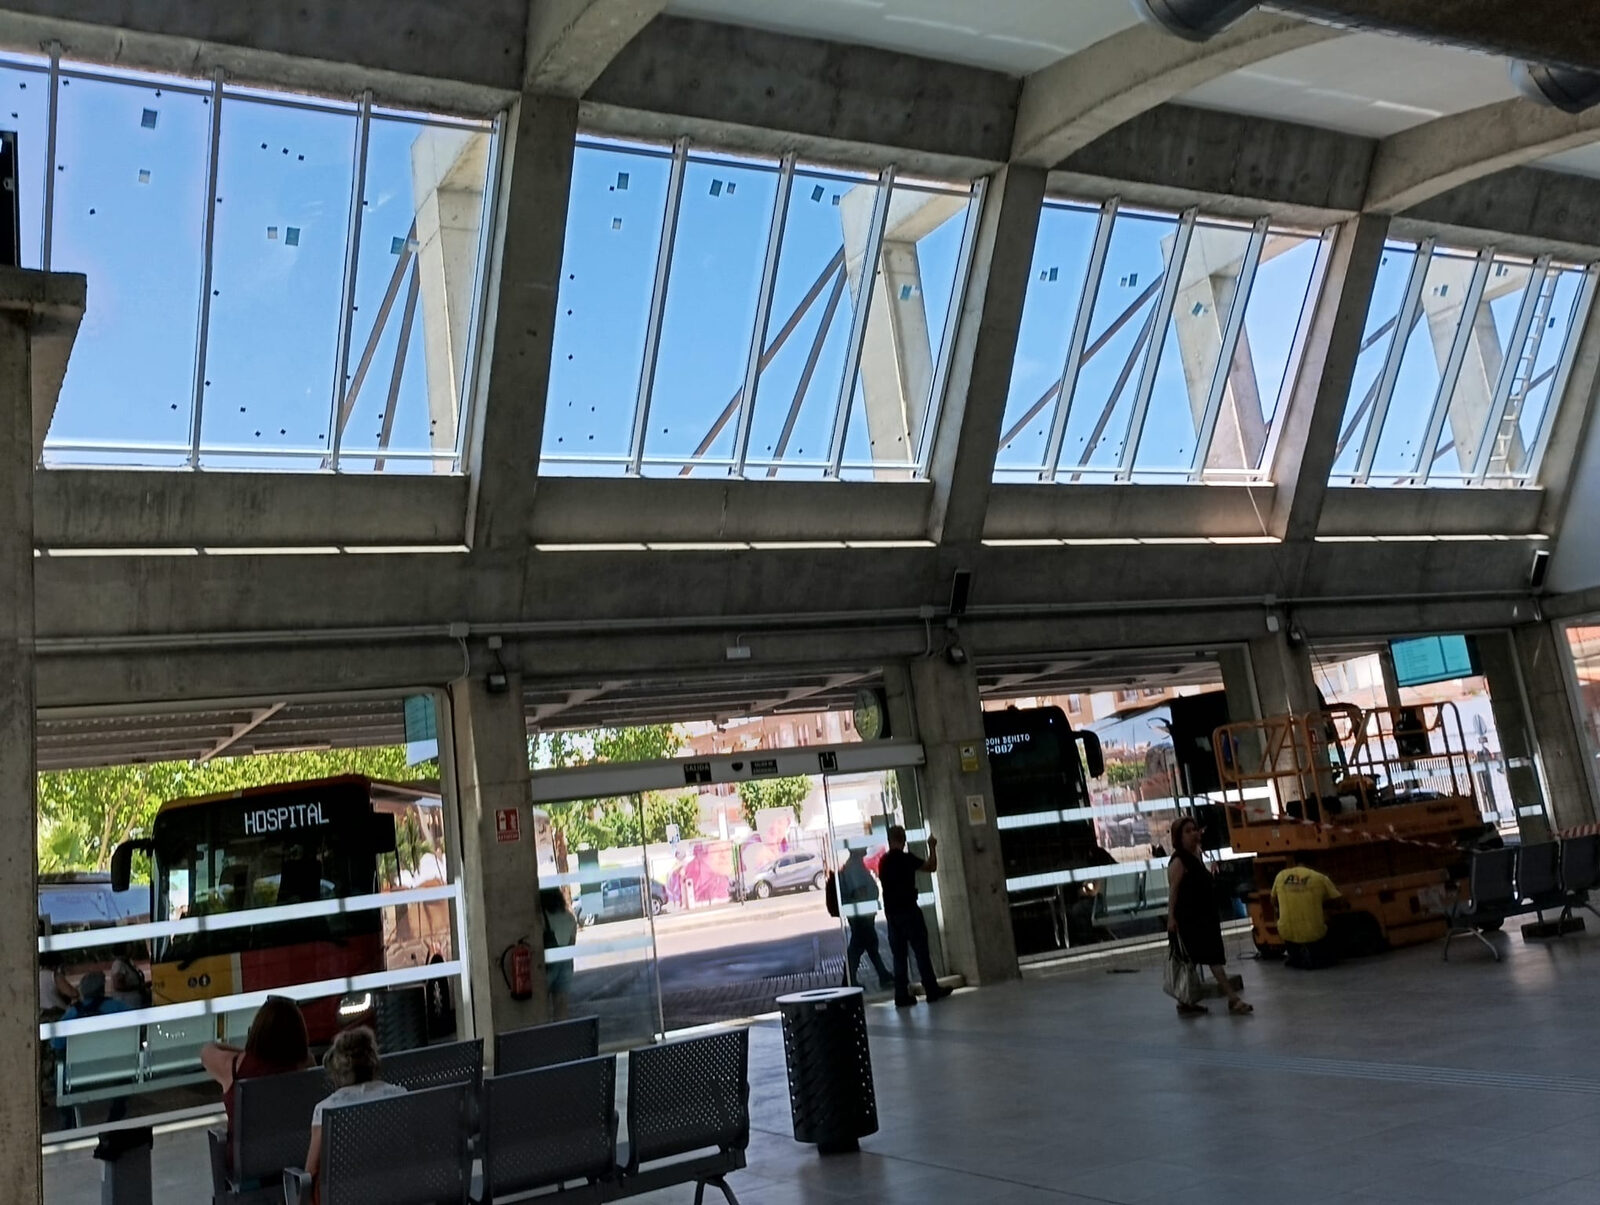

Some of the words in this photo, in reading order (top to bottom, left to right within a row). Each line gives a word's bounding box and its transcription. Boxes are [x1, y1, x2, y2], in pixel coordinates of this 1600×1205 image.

[1002, 733, 1030, 744] BENITO
[685, 763, 710, 773] SALIDA
[244, 801, 330, 835] HOSPITAL
